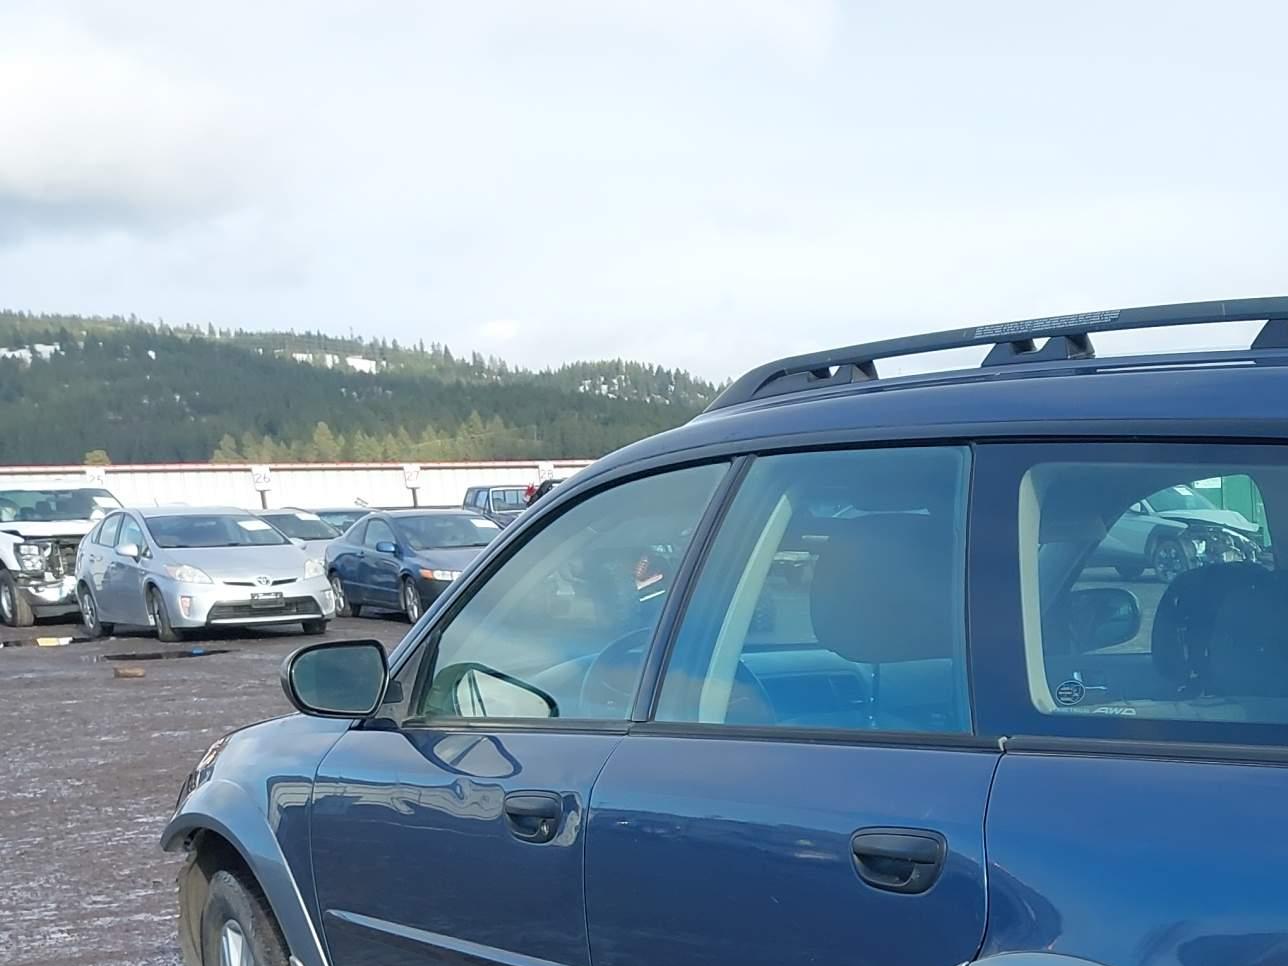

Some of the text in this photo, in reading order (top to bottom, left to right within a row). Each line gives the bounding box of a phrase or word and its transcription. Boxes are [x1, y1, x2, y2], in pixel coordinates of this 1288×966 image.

[88, 473, 104, 486] 25
[254, 472, 271, 484] 26
[406, 471, 420, 481] 27
[1092, 706, 1137, 716] AWD
